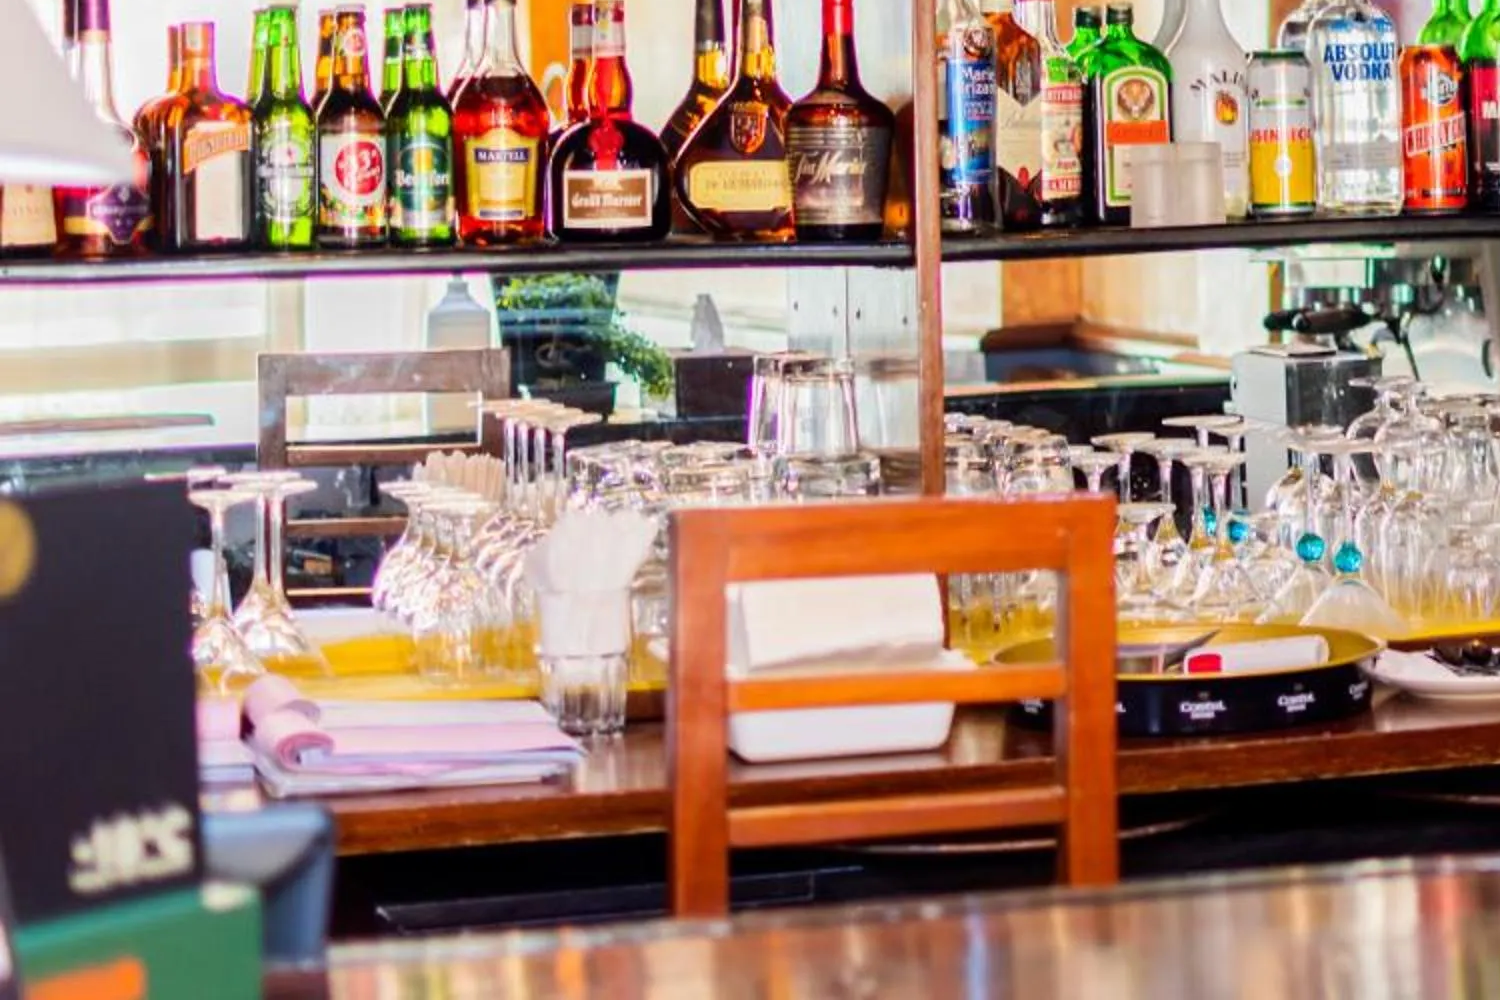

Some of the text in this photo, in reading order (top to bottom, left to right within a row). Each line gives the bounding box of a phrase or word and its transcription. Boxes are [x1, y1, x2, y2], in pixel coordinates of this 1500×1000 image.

[1323, 43, 1395, 63] ABSOLUT
[1331, 63, 1392, 81] VODKA
[477, 149, 526, 161] MARTELL
